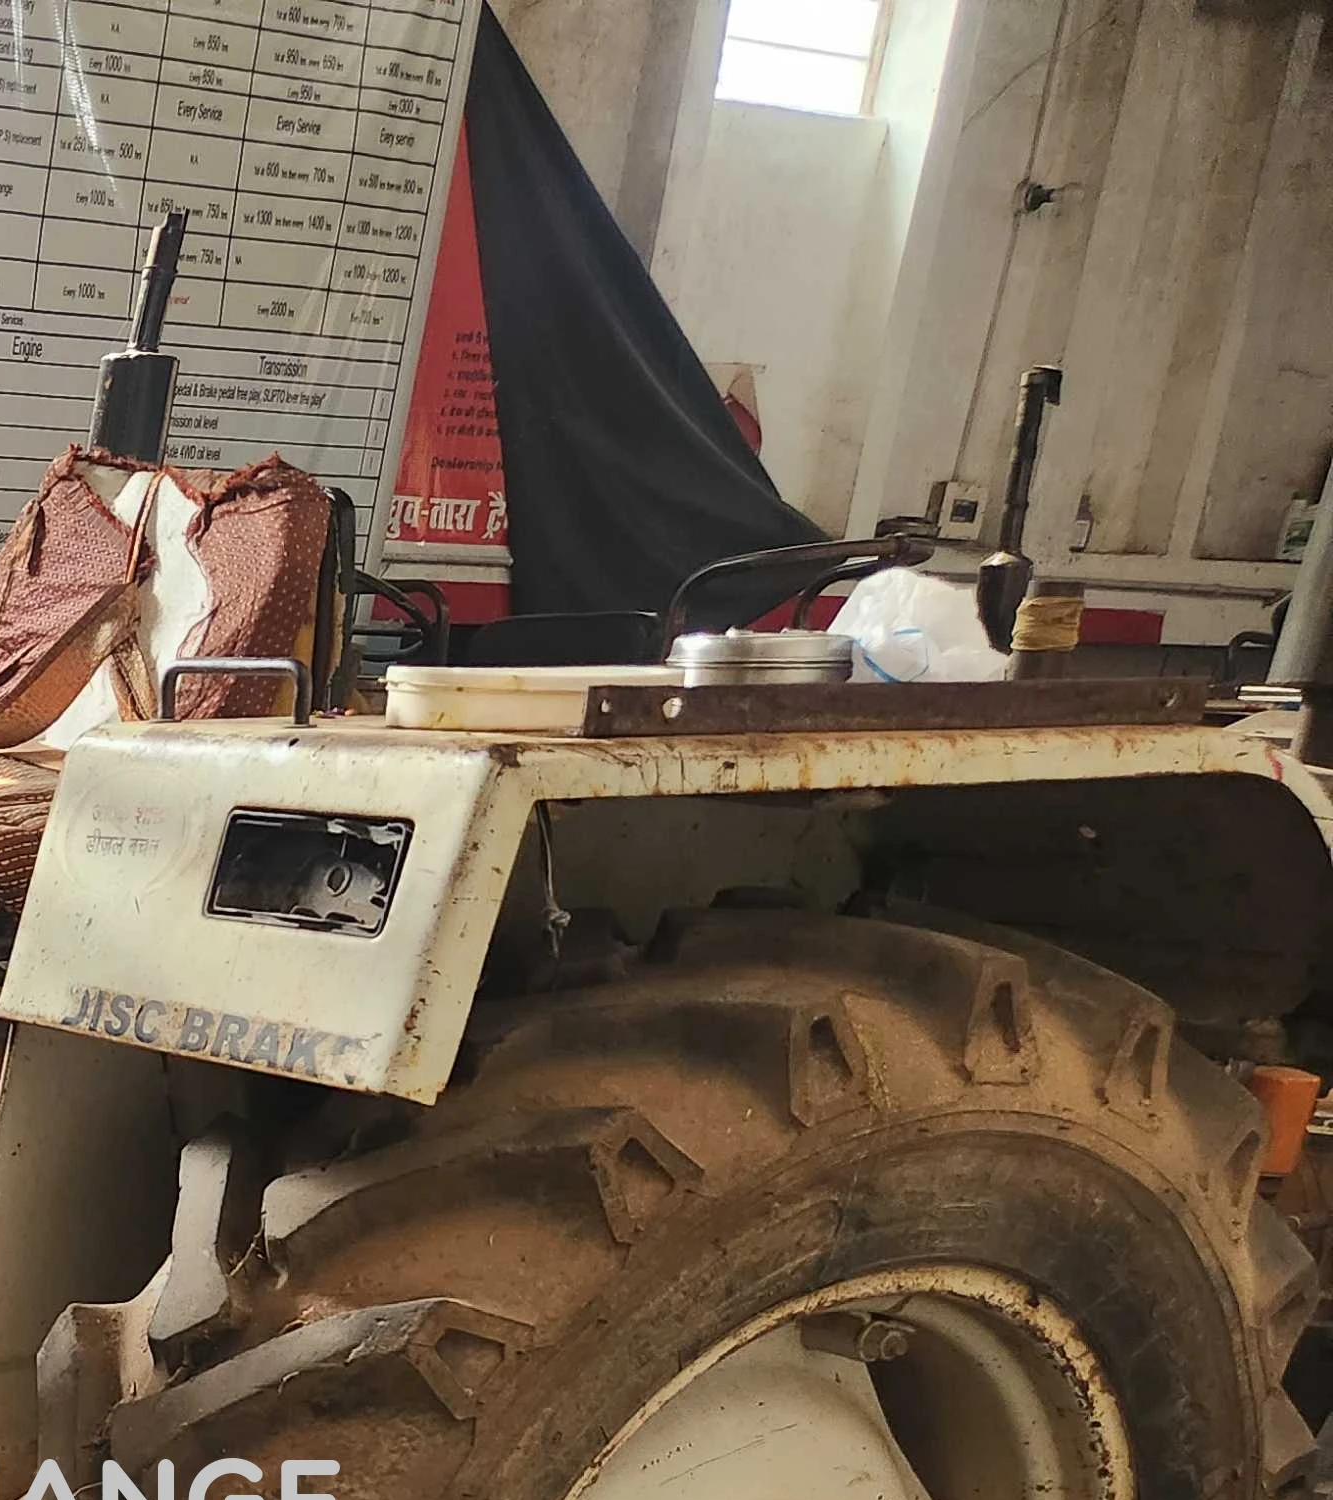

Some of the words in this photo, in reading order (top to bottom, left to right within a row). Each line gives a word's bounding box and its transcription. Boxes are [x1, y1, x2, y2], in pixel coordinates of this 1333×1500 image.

[177, 101, 197, 122] Every
[197, 104, 223, 122] Service
[276, 115, 301, 137] Every
[302, 118, 321, 136] Service
[90, 189, 106, 206] 1000
[78, 282, 96, 299] 1000
[12, 336, 43, 361] Engine
[259, 355, 308, 377] Transmission
